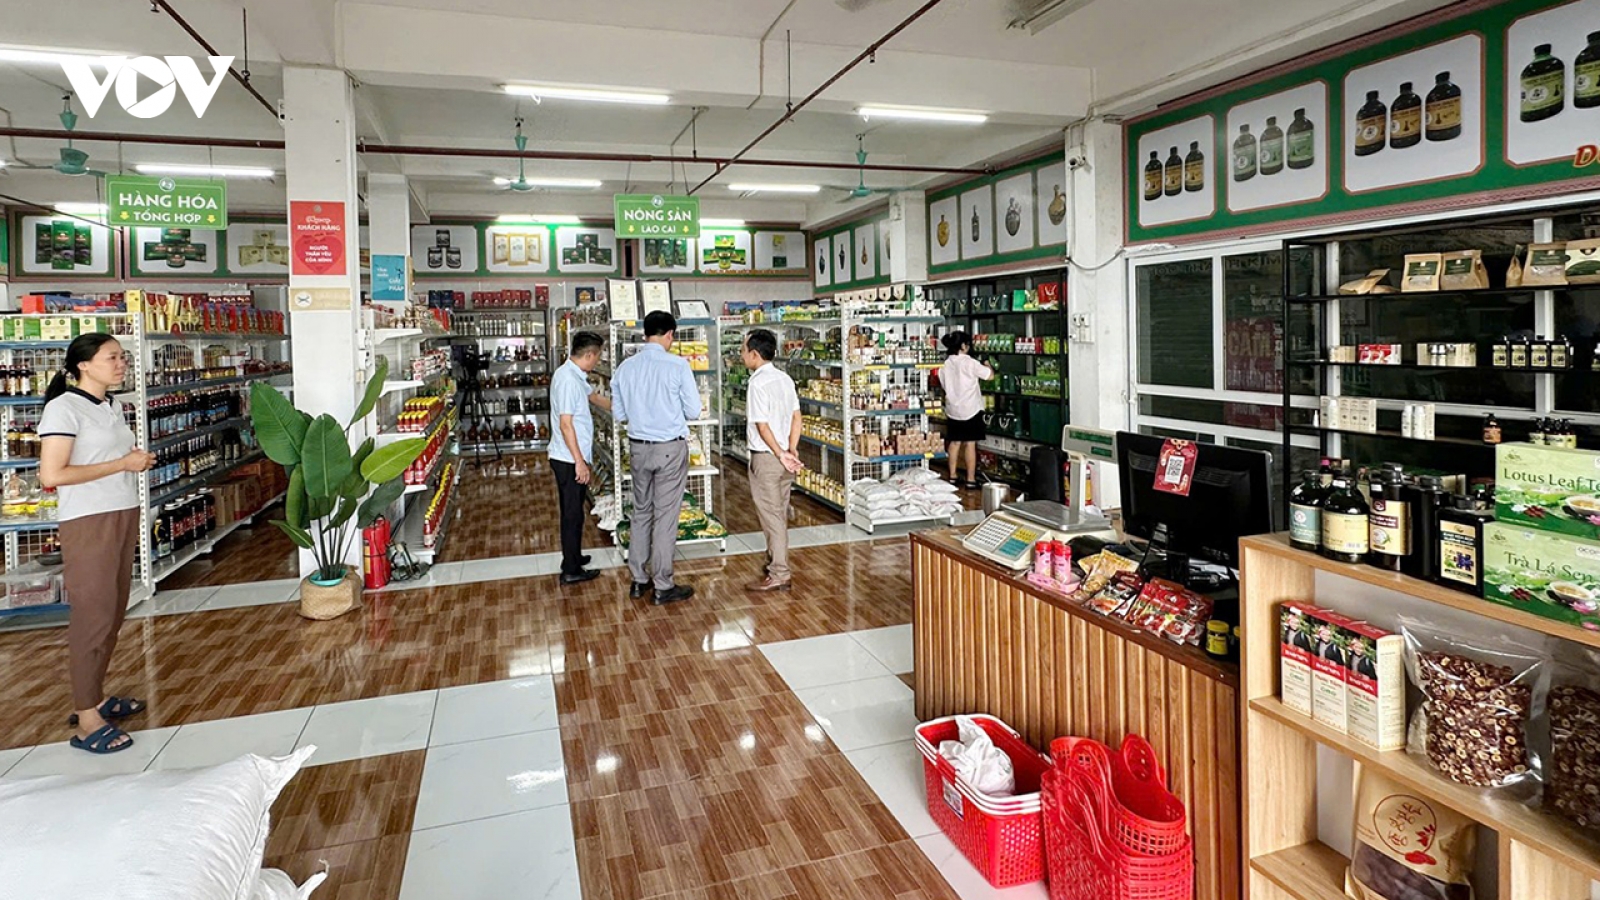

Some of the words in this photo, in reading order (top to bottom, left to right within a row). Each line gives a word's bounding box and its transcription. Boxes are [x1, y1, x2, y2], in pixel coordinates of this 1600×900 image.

[119, 190, 172, 208] HÀNG
[178, 194, 218, 210] HÓA
[133, 208, 171, 222] TỔNG
[174, 212, 202, 224] HỢP
[624, 207, 664, 221] NÔNG
[667, 206, 692, 221] SẢN
[297, 223, 321, 231] KHÁCH
[641, 224, 660, 234] LÀO
[661, 225, 676, 234] CAI
[1504, 468, 1545, 483] Lotus
[1549, 474, 1584, 491] Leaf
[1503, 551, 1530, 568] Trà
[1535, 558, 1556, 575] Lá
[1561, 565, 1593, 582] Sen
